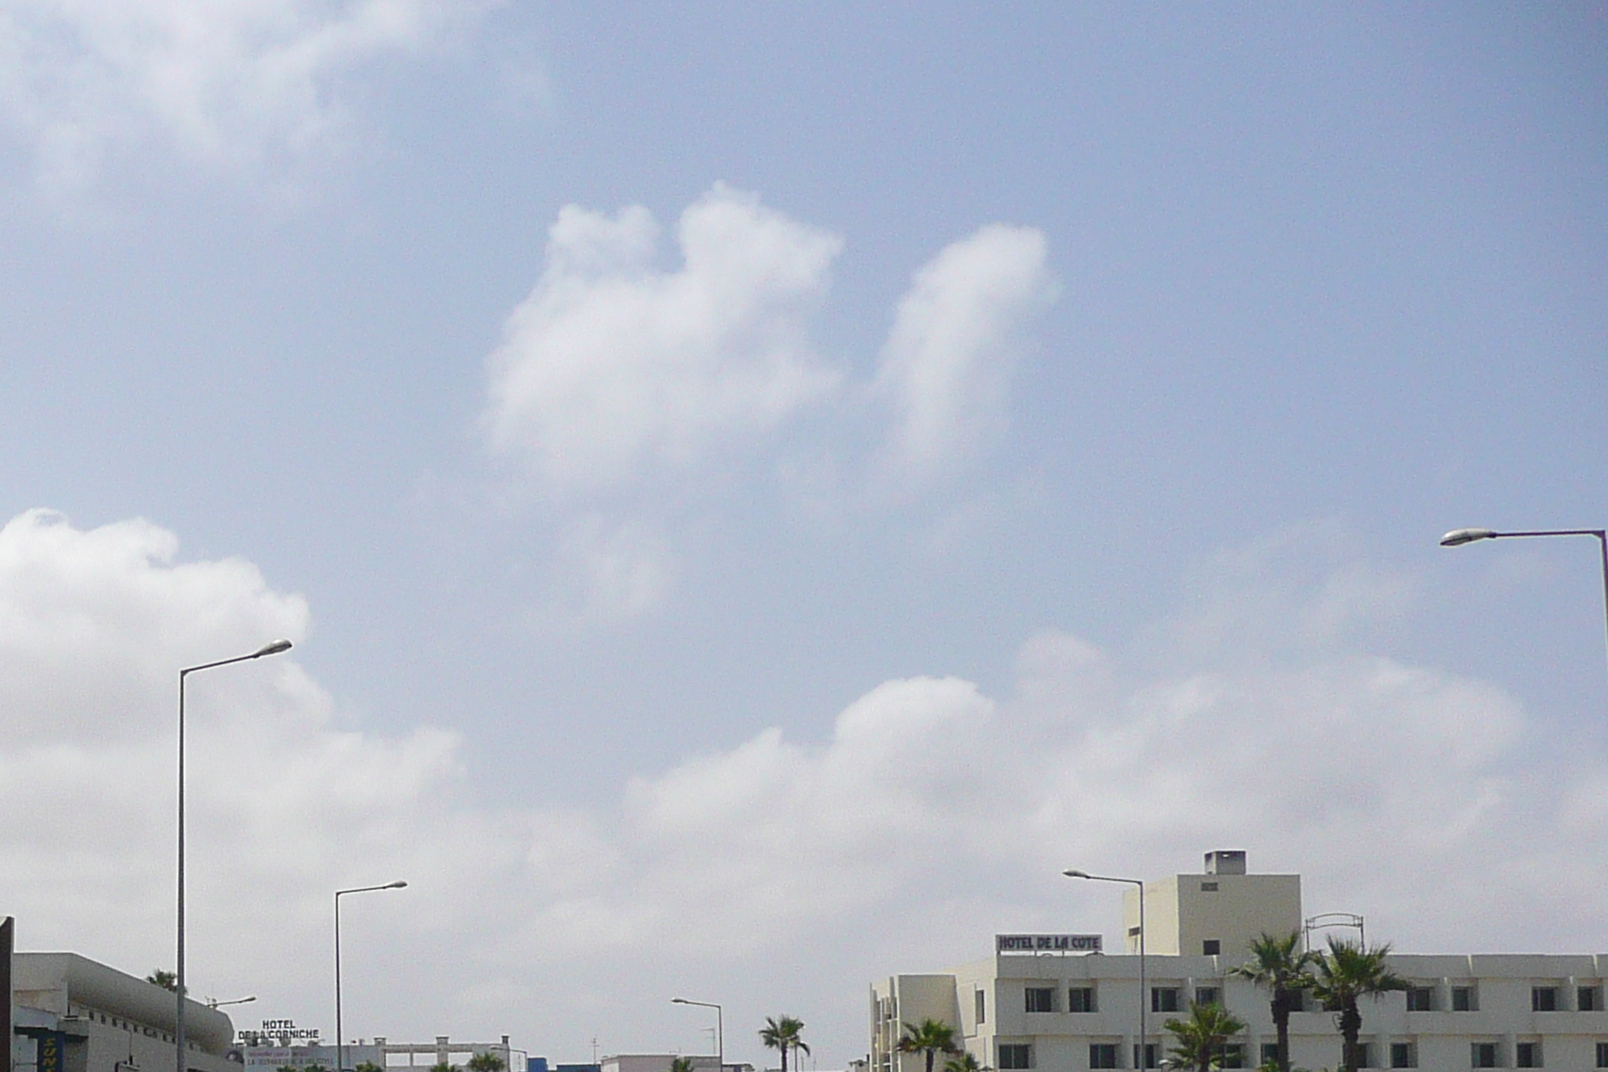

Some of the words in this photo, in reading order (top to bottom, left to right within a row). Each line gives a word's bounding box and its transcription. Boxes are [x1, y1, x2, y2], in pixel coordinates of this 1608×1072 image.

[999, 936, 1033, 949] HOTEL
[1037, 936, 1052, 949] DE
[1054, 936, 1068, 949] LA
[262, 1020, 296, 1029] HOTEL
[238, 1031, 252, 1040] DE
[268, 1029, 320, 1039] CORNICHE
